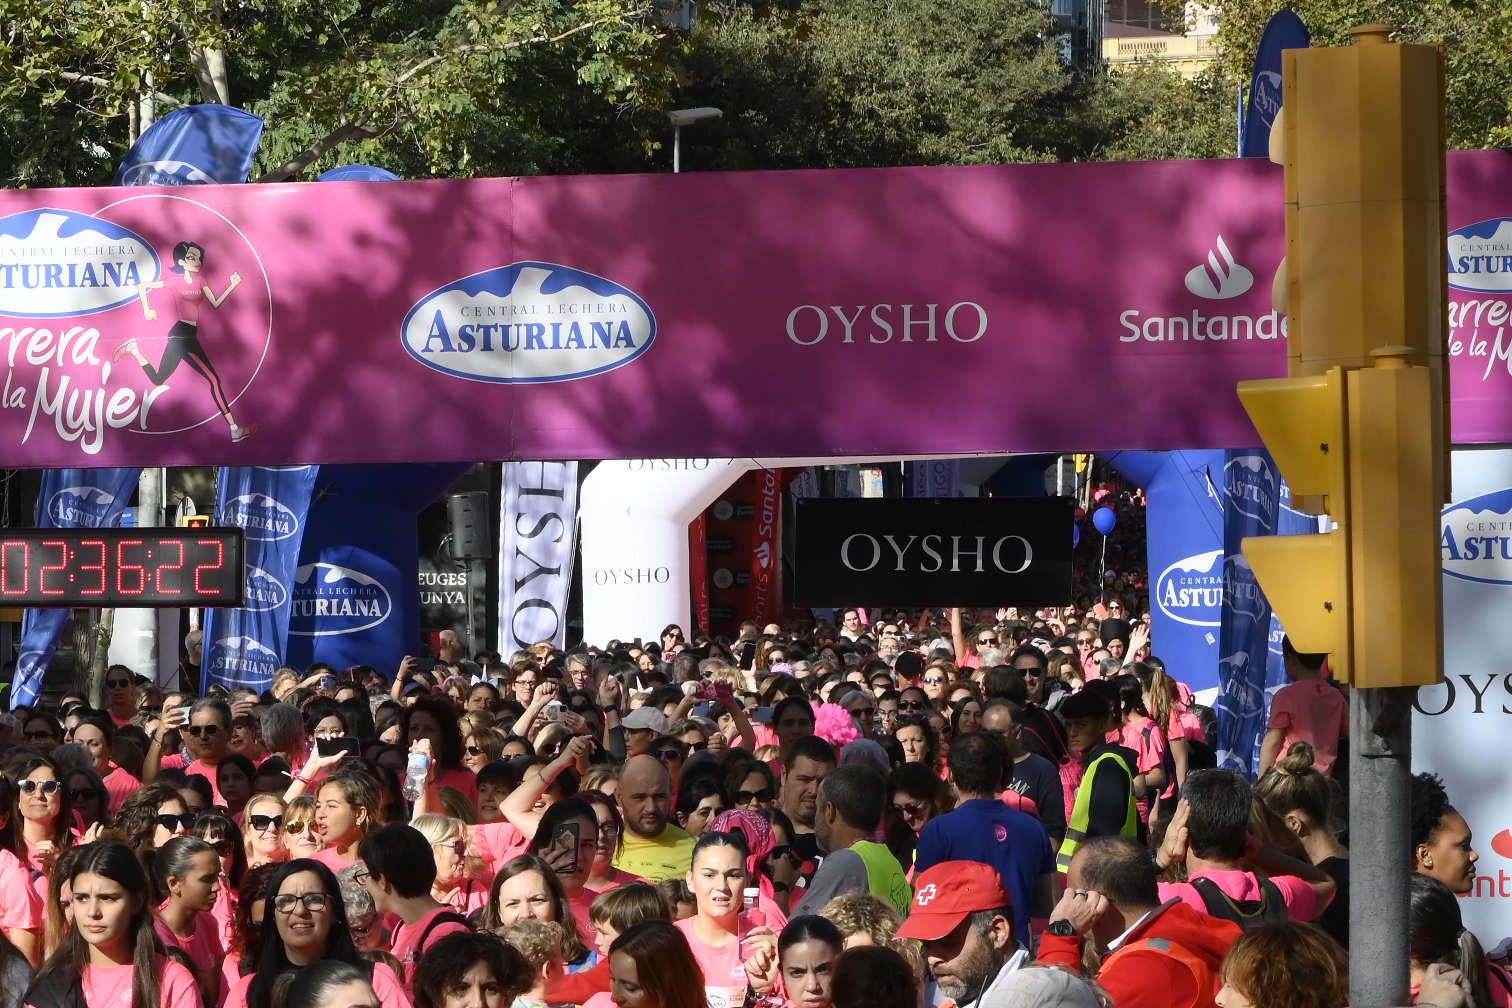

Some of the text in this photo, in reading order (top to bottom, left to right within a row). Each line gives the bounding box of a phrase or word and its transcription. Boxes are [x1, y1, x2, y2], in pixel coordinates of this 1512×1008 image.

[63, 245, 136, 256] LECHERA
[461, 303, 628, 317] CENTRAL LECHERA
[786, 302, 988, 346] OYSHO
[1448, 299, 1512, 328] arre
[421, 309, 637, 354] ASTURIANA
[1469, 329, 1488, 356] la
[1, 368, 27, 409] la
[21, 361, 171, 455] Mujer
[1, 540, 224, 595] 02:36:22
[841, 534, 1033, 574] OYSHO
[595, 566, 671, 586] OYSHO
